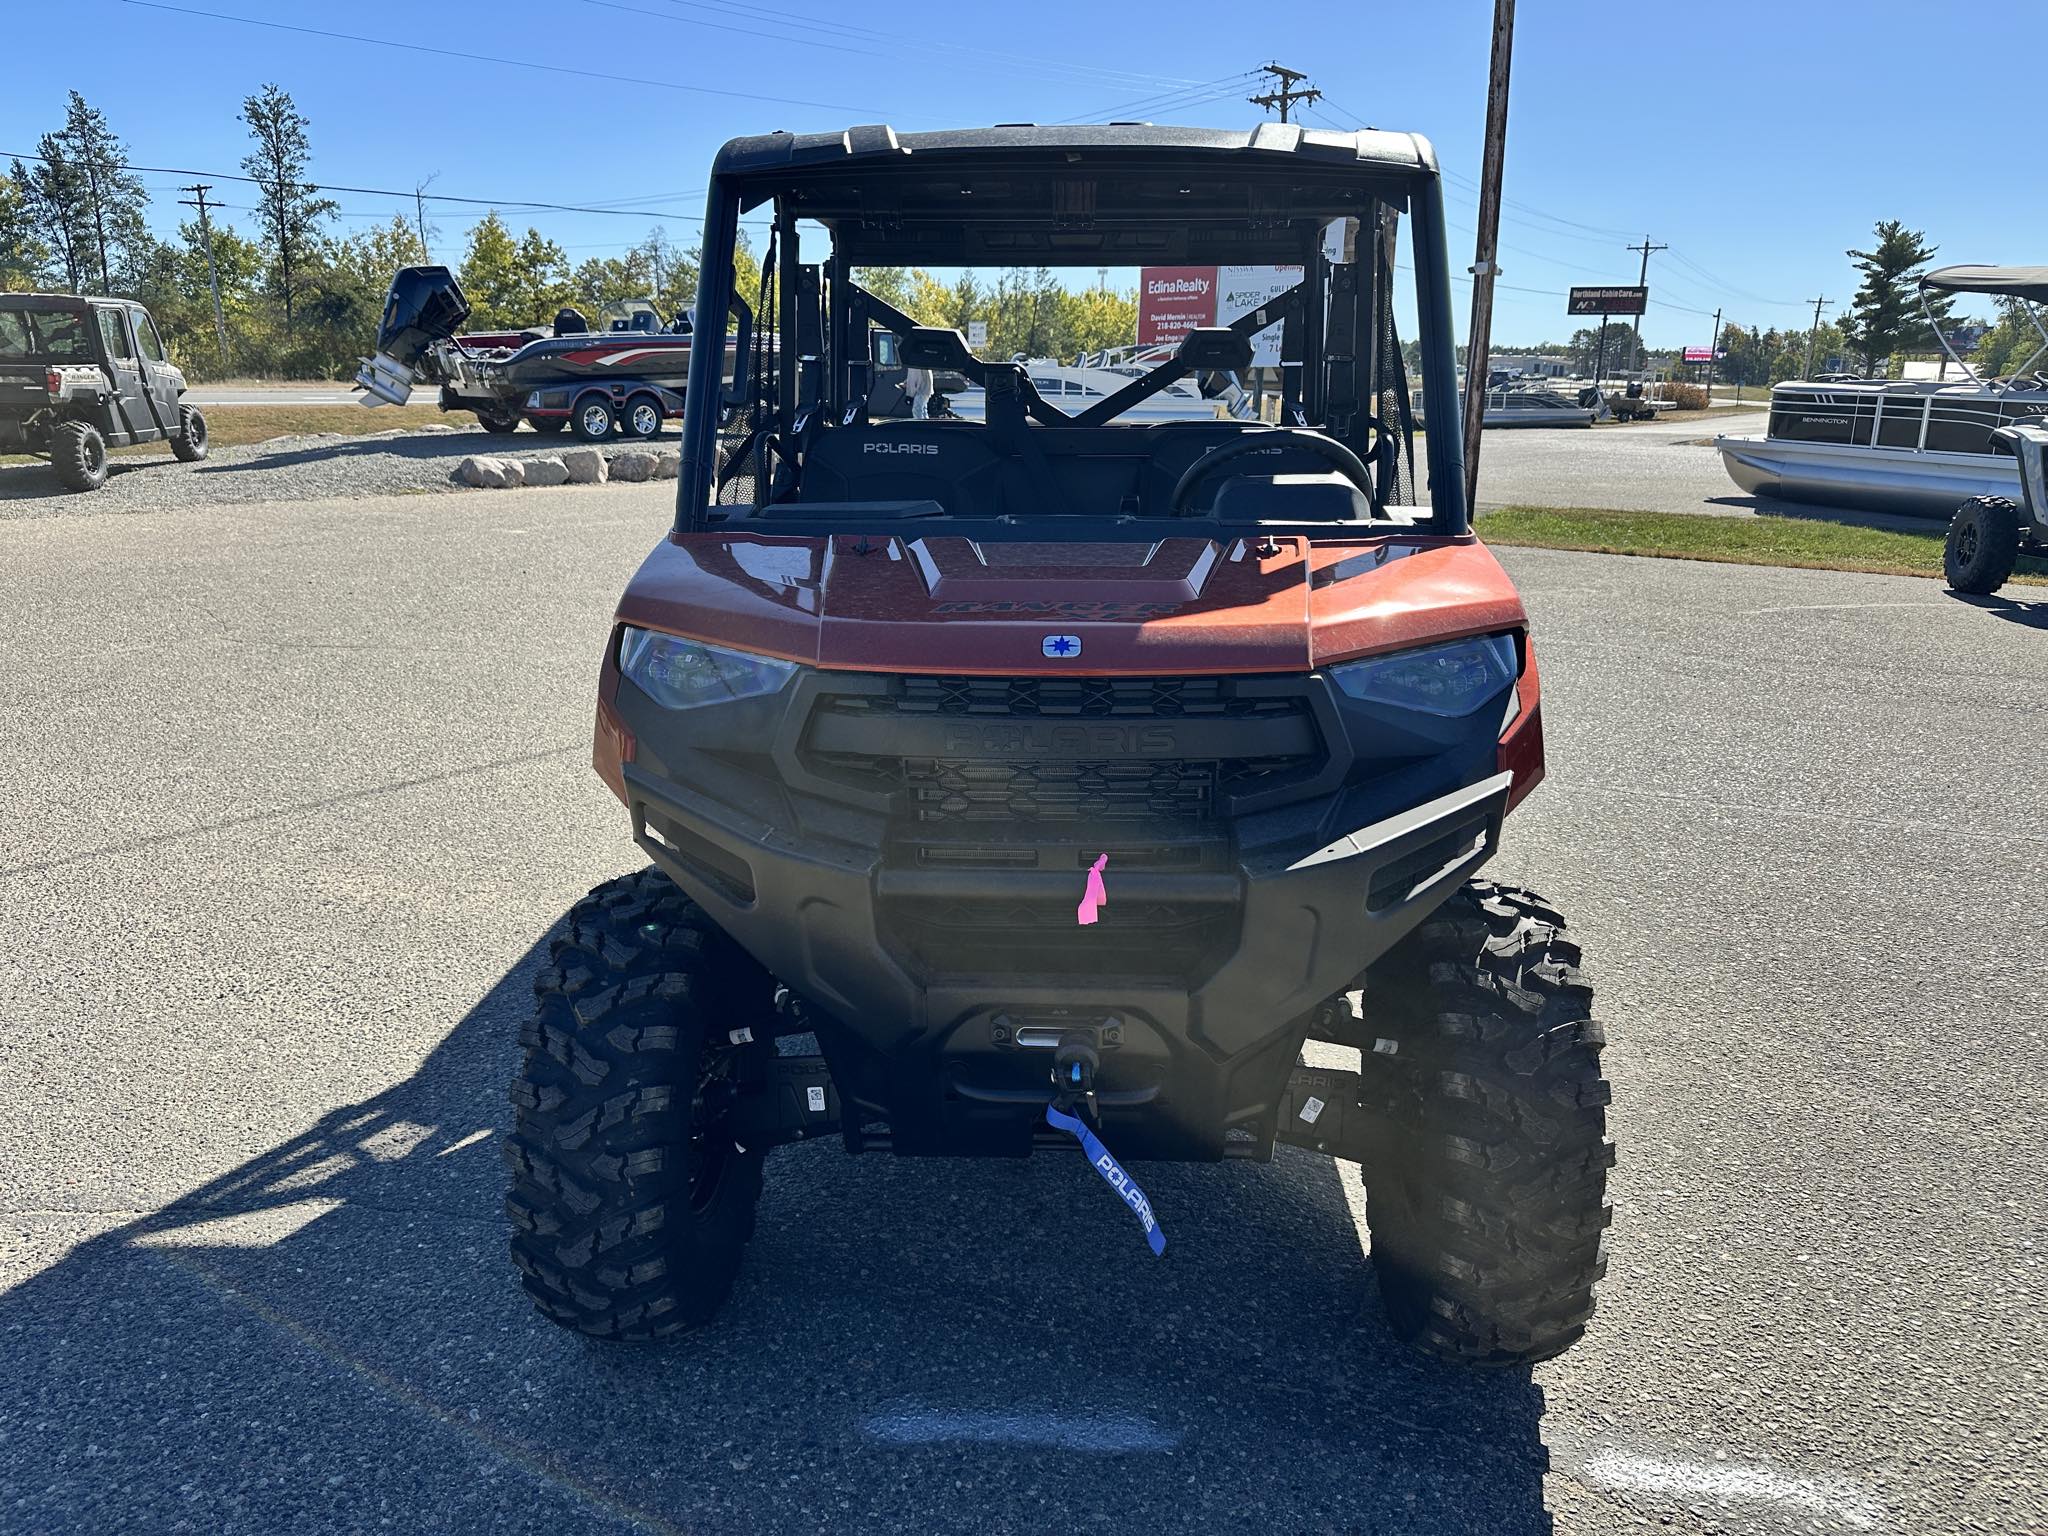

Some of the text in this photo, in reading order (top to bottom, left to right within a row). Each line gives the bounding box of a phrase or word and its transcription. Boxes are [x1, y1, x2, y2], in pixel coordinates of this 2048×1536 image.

[1148, 278, 1210, 294] Edina Realty
[1235, 291, 1260, 299] SPIDER
[1572, 289, 1601, 298] Northland
[1235, 299, 1260, 308] LAKE
[1150, 313, 1166, 321] David
[1155, 334, 1164, 342] Joe
[1262, 332, 1280, 342] Single
[1802, 416, 1848, 425] BENNINGTON
[863, 442, 939, 455] POLARIS
[929, 601, 1184, 613] RANGER
[944, 724, 1178, 753] POLARIS
[1096, 1154, 1155, 1233] POLARIS
